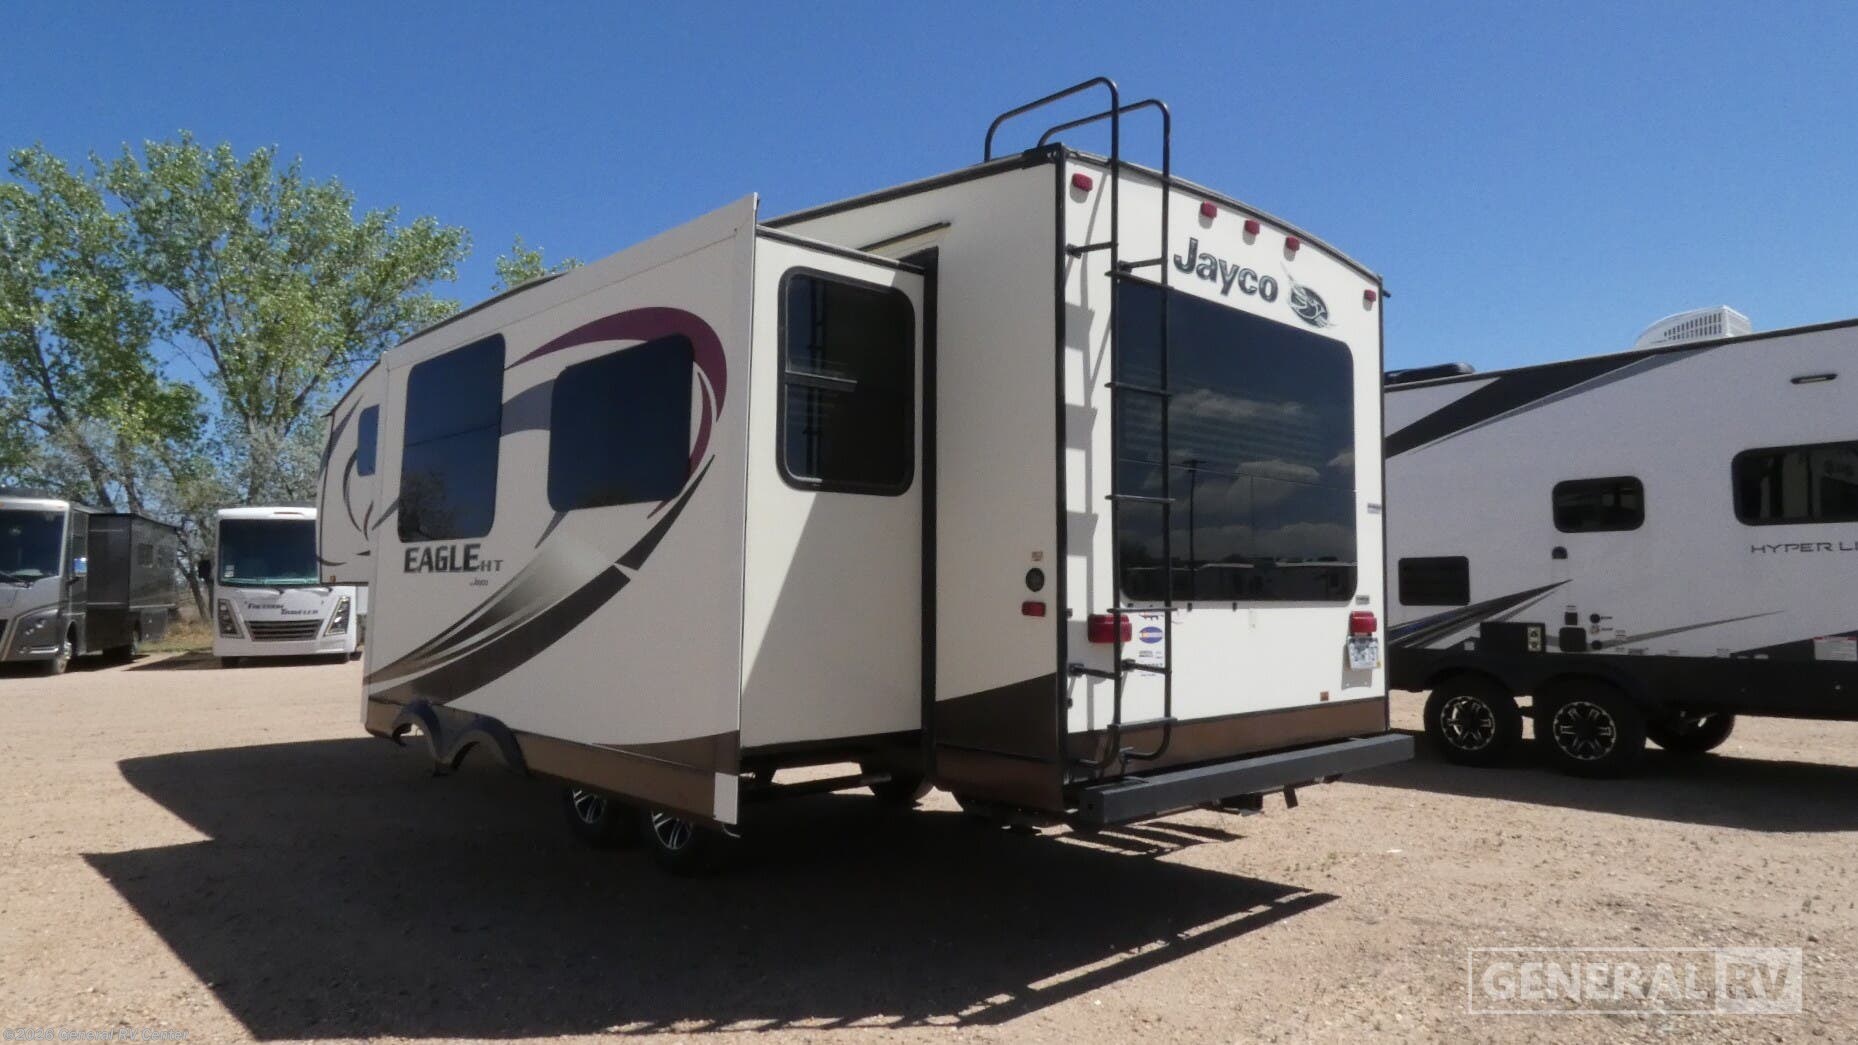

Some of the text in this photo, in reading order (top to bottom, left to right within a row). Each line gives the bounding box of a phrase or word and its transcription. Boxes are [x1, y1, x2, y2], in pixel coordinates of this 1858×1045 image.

[1173, 237, 1279, 303] Jayco
[403, 543, 504, 573] EAGLE HT
[1751, 542, 1832, 553] HYPER
